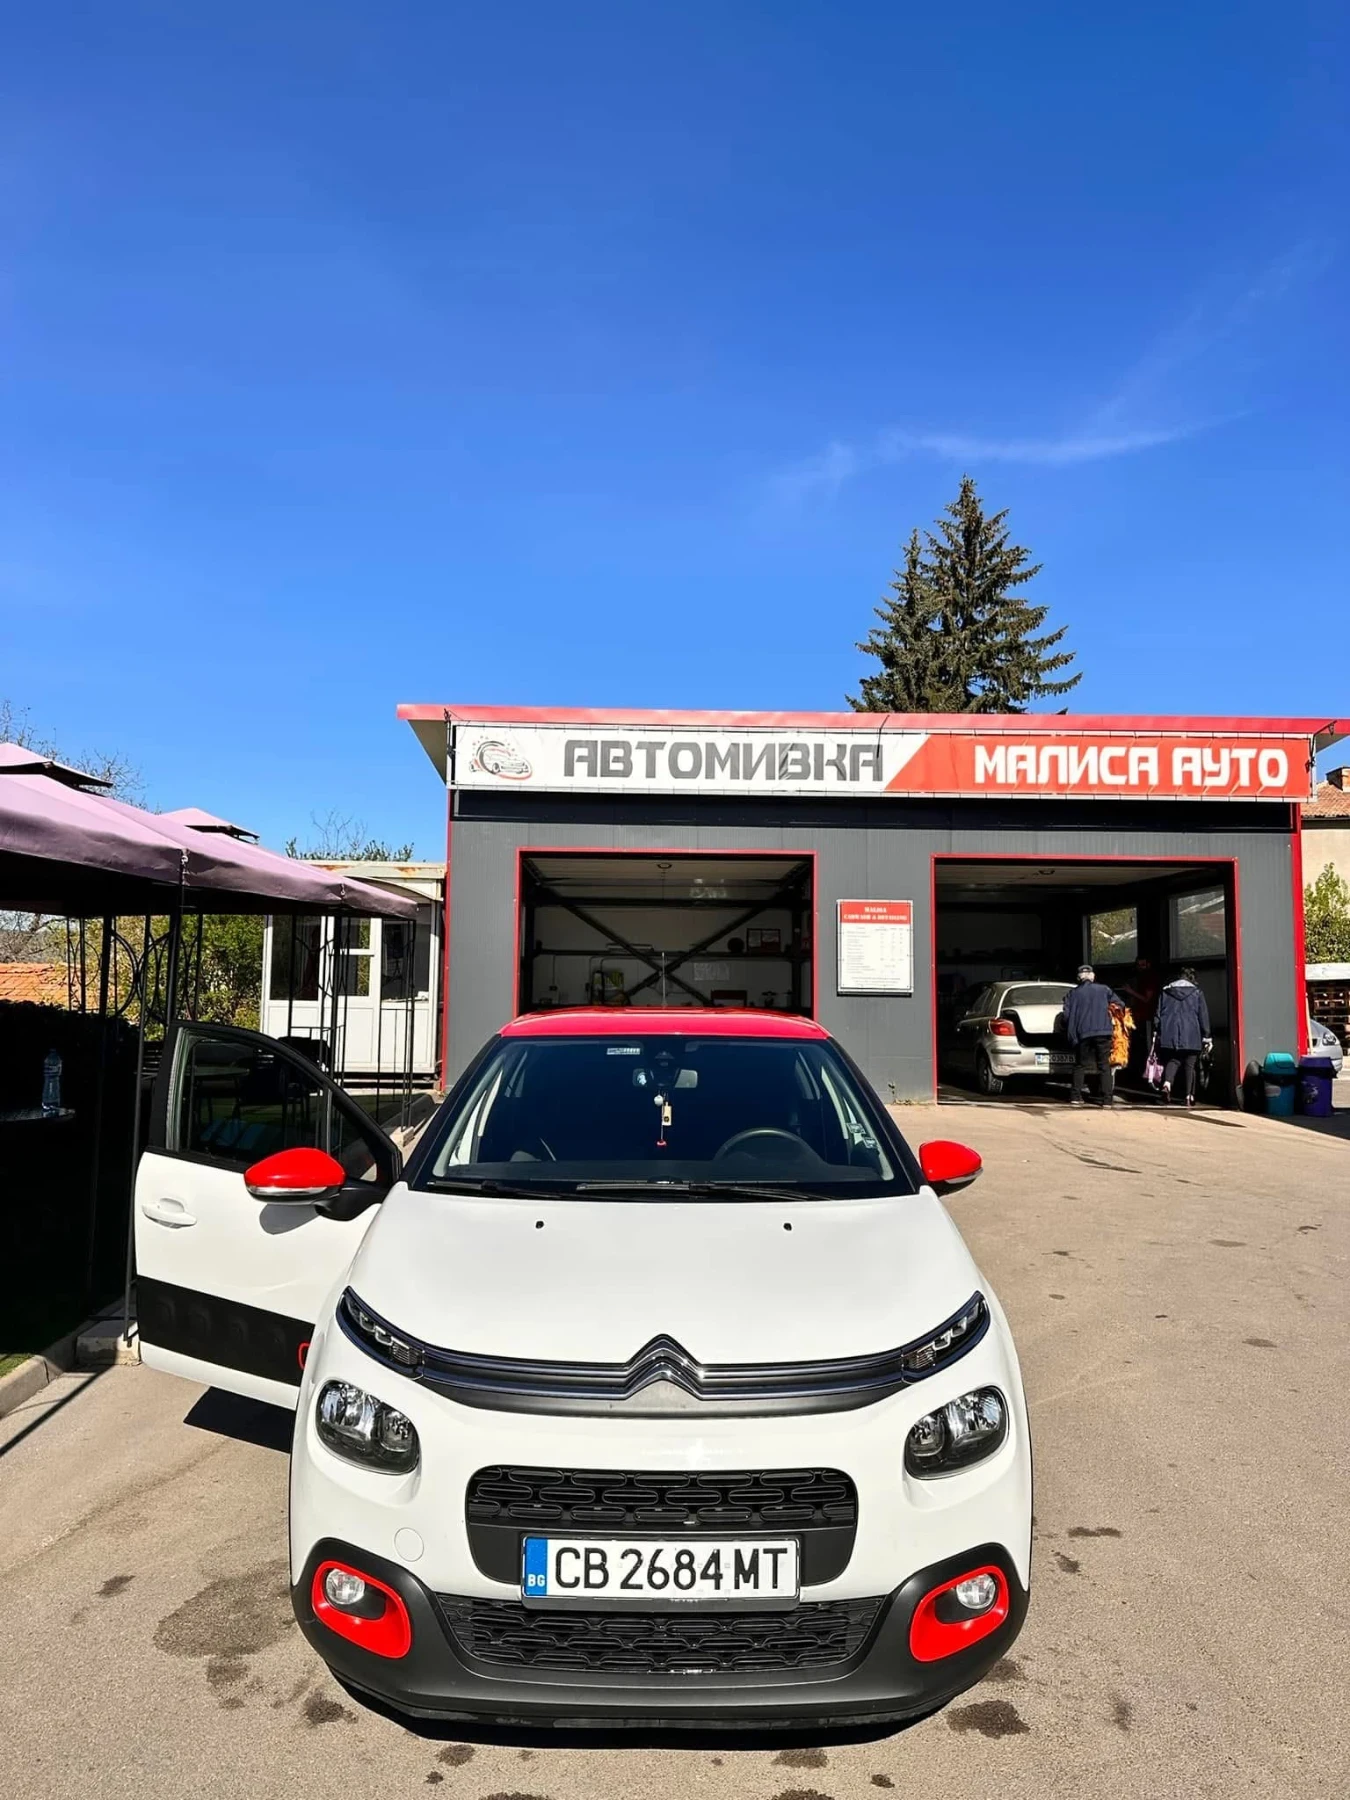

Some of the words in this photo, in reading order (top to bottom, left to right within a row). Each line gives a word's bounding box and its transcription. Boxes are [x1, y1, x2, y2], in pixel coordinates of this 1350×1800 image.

[563, 739, 884, 782] АВТОМИВКА
[974, 744, 1160, 787] МАЛИСА
[1171, 747, 1289, 788] АУТО
[527, 1573, 546, 1588] BG
[555, 1547, 610, 1589] CB
[619, 1548, 723, 1591] 2684
[734, 1548, 788, 1590] MT
